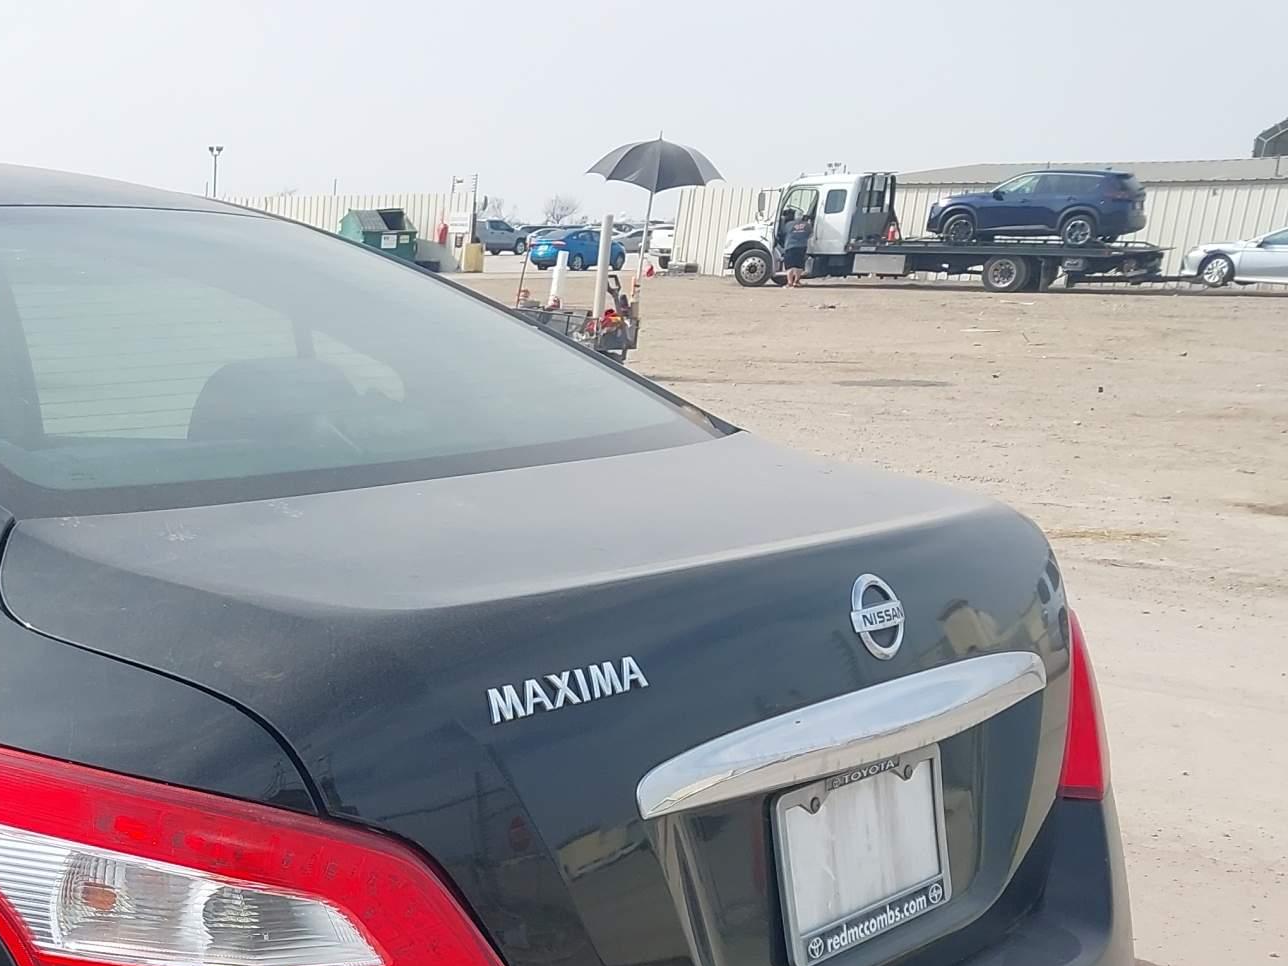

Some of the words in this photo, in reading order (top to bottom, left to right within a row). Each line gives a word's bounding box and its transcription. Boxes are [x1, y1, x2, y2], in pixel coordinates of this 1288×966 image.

[861, 606, 904, 627] NISSAN
[487, 655, 649, 725] MAXIMA
[843, 759, 895, 785] TOYOTA
[826, 893, 928, 953] redmccombs.com
